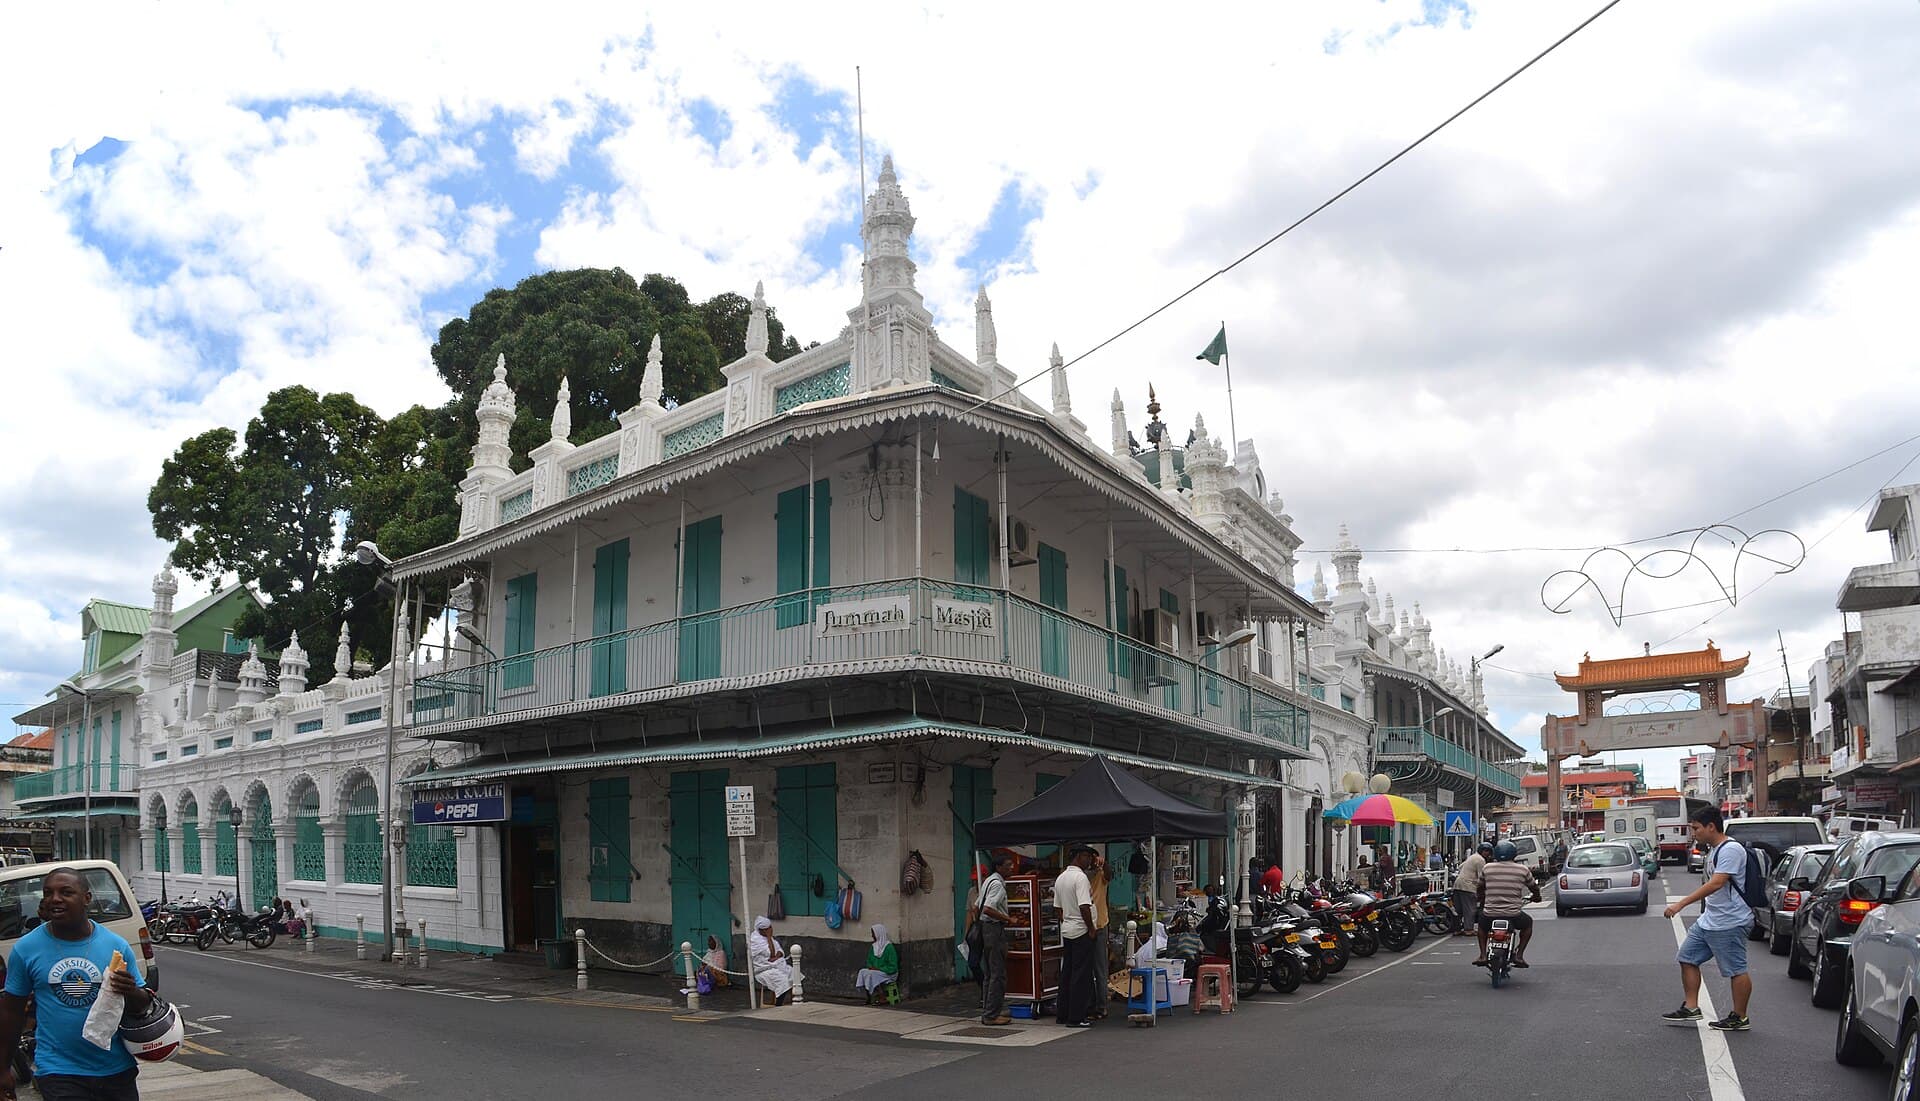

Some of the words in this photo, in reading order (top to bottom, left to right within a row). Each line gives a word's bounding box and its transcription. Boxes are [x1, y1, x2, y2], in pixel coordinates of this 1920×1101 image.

[822, 604, 904, 634] Jummah
[936, 605, 992, 631] Masjid
[464, 783, 504, 799] SNACK
[446, 803, 479, 819] PEPSI
[51, 959, 100, 978] QUIKSILVER
